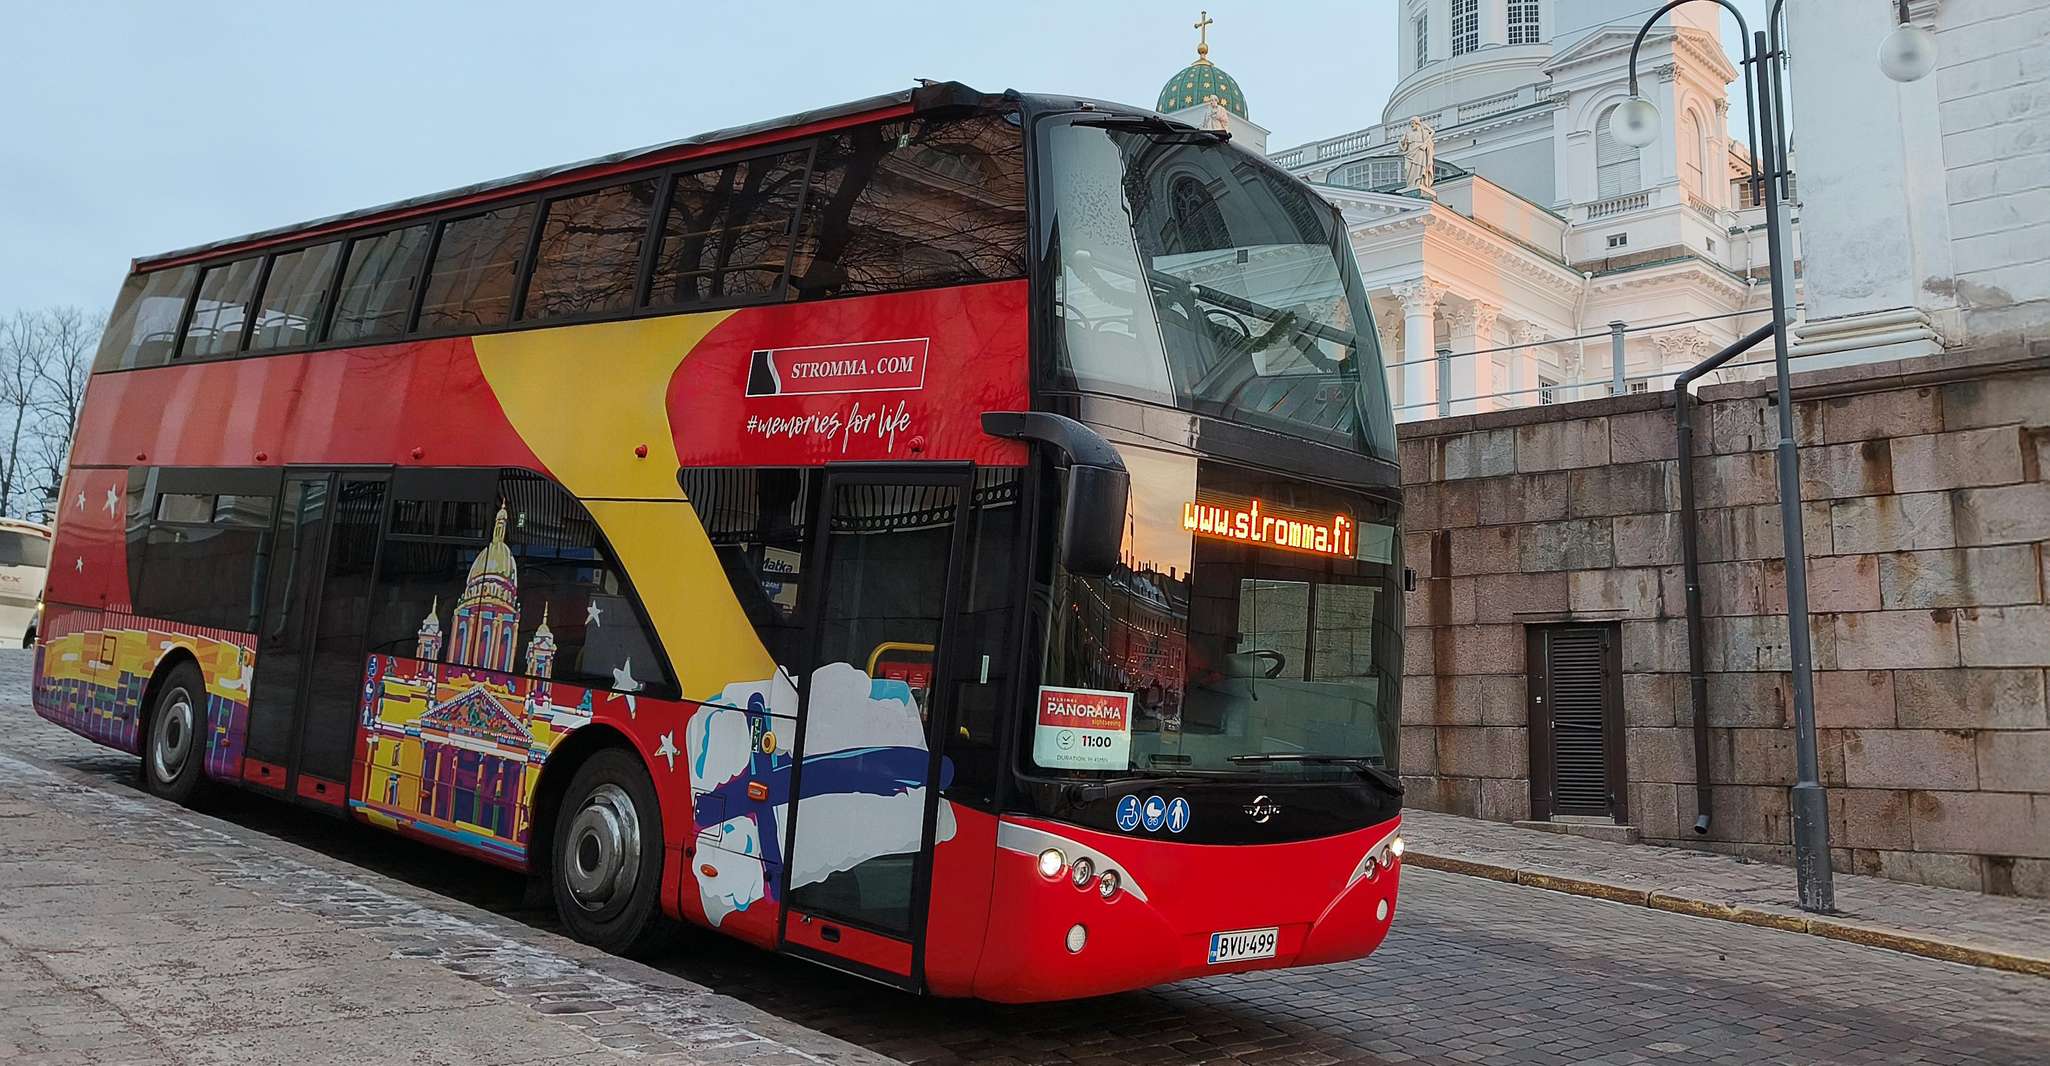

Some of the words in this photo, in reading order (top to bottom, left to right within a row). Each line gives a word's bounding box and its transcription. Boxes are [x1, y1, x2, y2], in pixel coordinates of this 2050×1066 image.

[747, 411, 842, 440] #memories
[842, 402, 876, 454] for
[878, 400, 912, 453] life
[1184, 501, 1350, 555] www.stromma.fi
[1047, 702, 1121, 720] PANORAMA
[1082, 735, 1112, 747] 11:00
[1220, 933, 1274, 958] BVU-499
